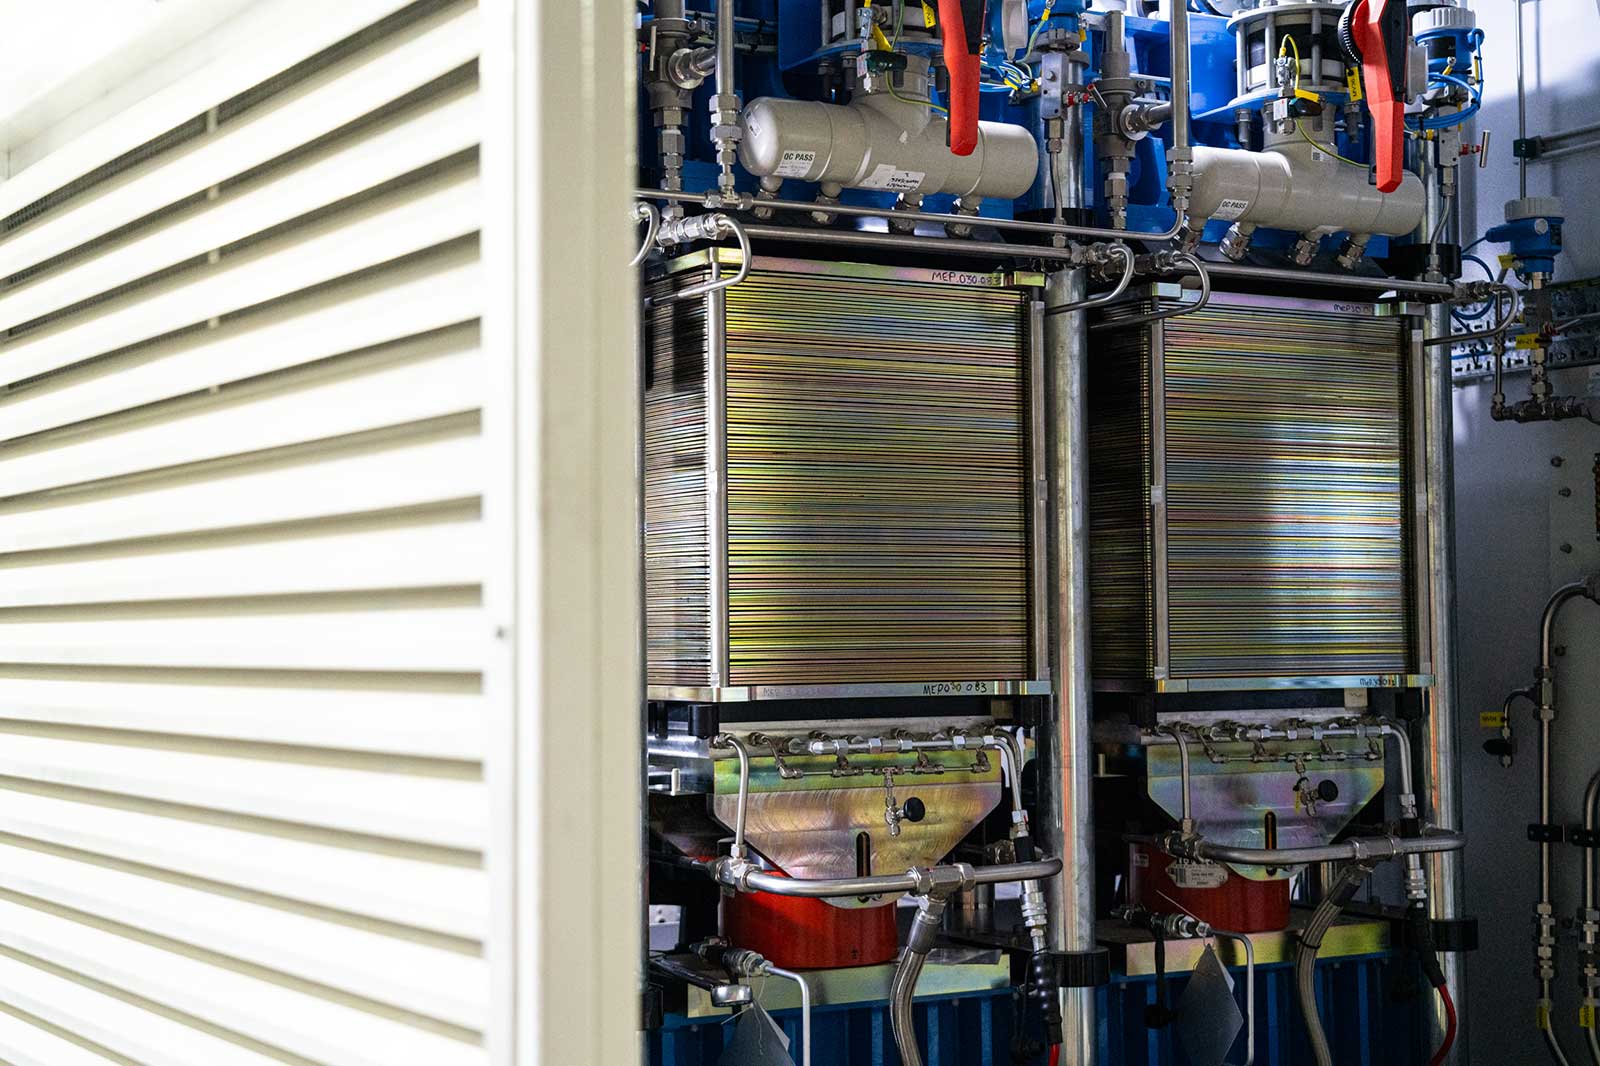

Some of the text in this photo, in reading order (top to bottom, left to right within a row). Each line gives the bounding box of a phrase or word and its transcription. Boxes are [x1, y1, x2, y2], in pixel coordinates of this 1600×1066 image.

[783, 152, 814, 162] QC PASS
[1231, 201, 1247, 209] PASS
